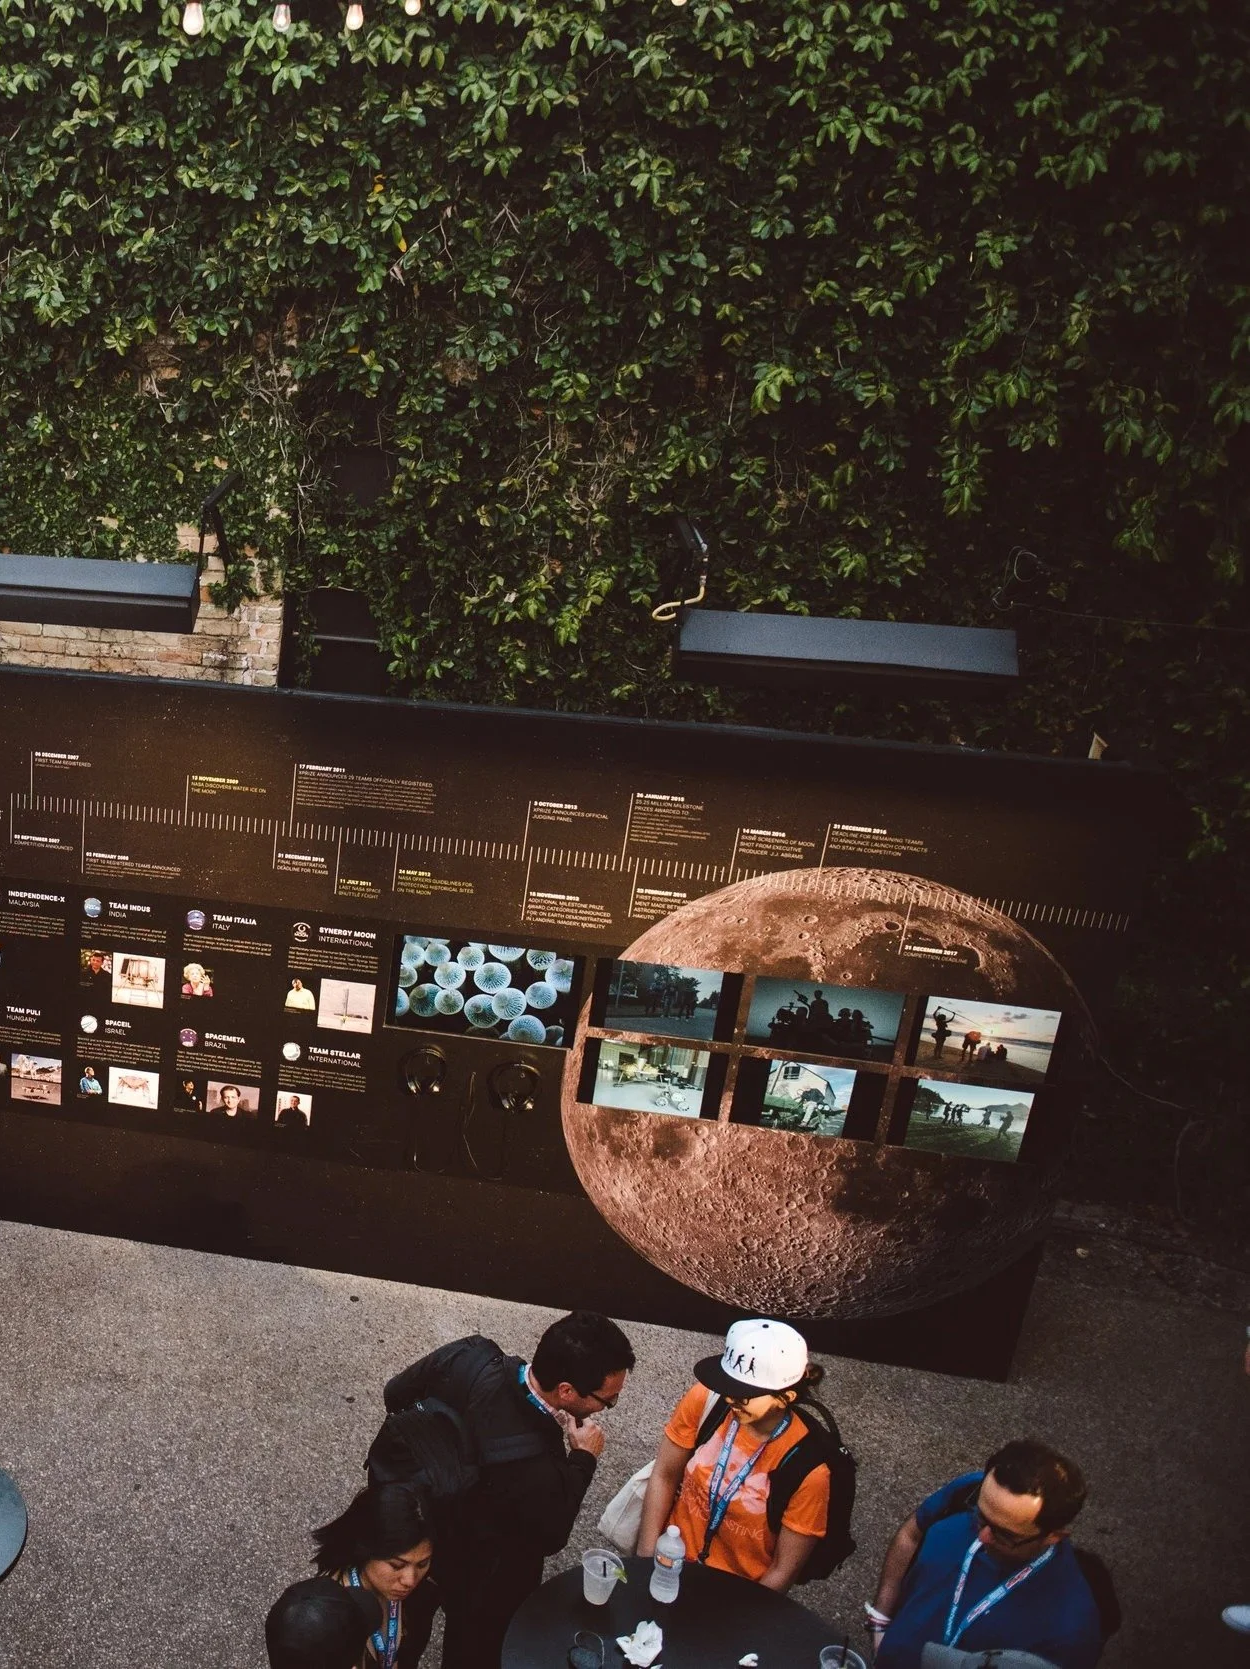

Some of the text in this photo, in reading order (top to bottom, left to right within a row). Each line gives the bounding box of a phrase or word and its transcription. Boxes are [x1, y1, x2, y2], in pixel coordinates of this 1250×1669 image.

[839, 838, 870, 846] ANNOUNCE
[8, 890, 65, 902] INDEPENDENCE-X
[8, 899, 40, 907] MALAYSIA
[234, 917, 257, 925] ITALIA
[319, 927, 352, 936] SYNERGY
[354, 930, 376, 939] MOON
[318, 936, 373, 948] INTERNATIONAL
[913, 946, 943, 954] DECEMBER
[941, 956, 968, 964] DEADLINE
[6, 1014, 37, 1023] HUNGARY
[105, 1019, 131, 1028] SPACEIL
[205, 1033, 245, 1043] SPACEMETA
[309, 1047, 361, 1059] TEAM STELLAR
[308, 1056, 361, 1068] INTERNATIONAL
